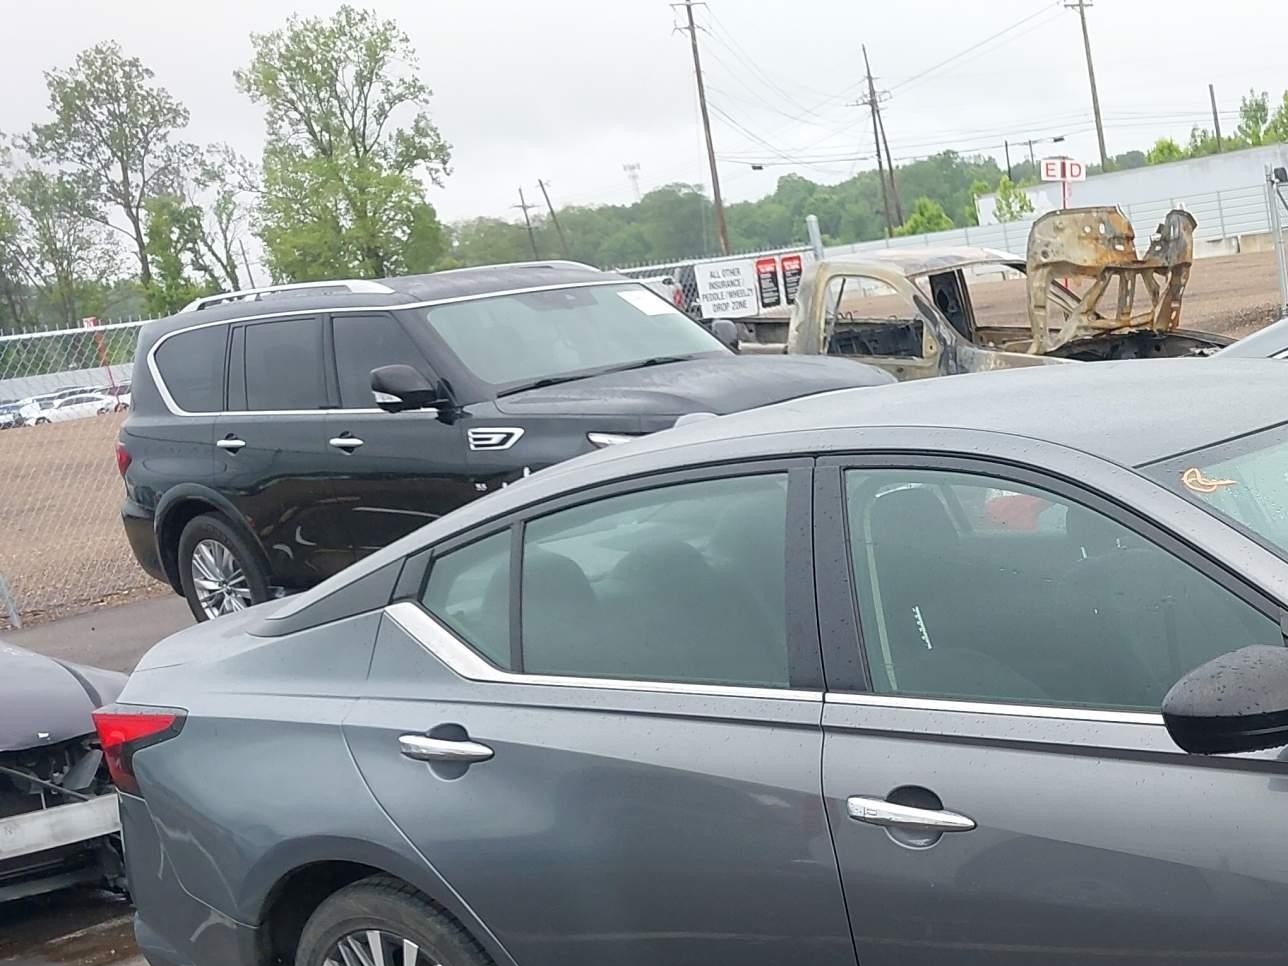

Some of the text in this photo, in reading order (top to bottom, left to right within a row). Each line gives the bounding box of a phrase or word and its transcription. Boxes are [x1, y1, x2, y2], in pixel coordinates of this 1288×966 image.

[1045, 162, 1081, 178] ED
[709, 267, 741, 279] ALL OTHER
[709, 279, 741, 290] INSURANCE
[712, 300, 748, 313] DROP ZONE
